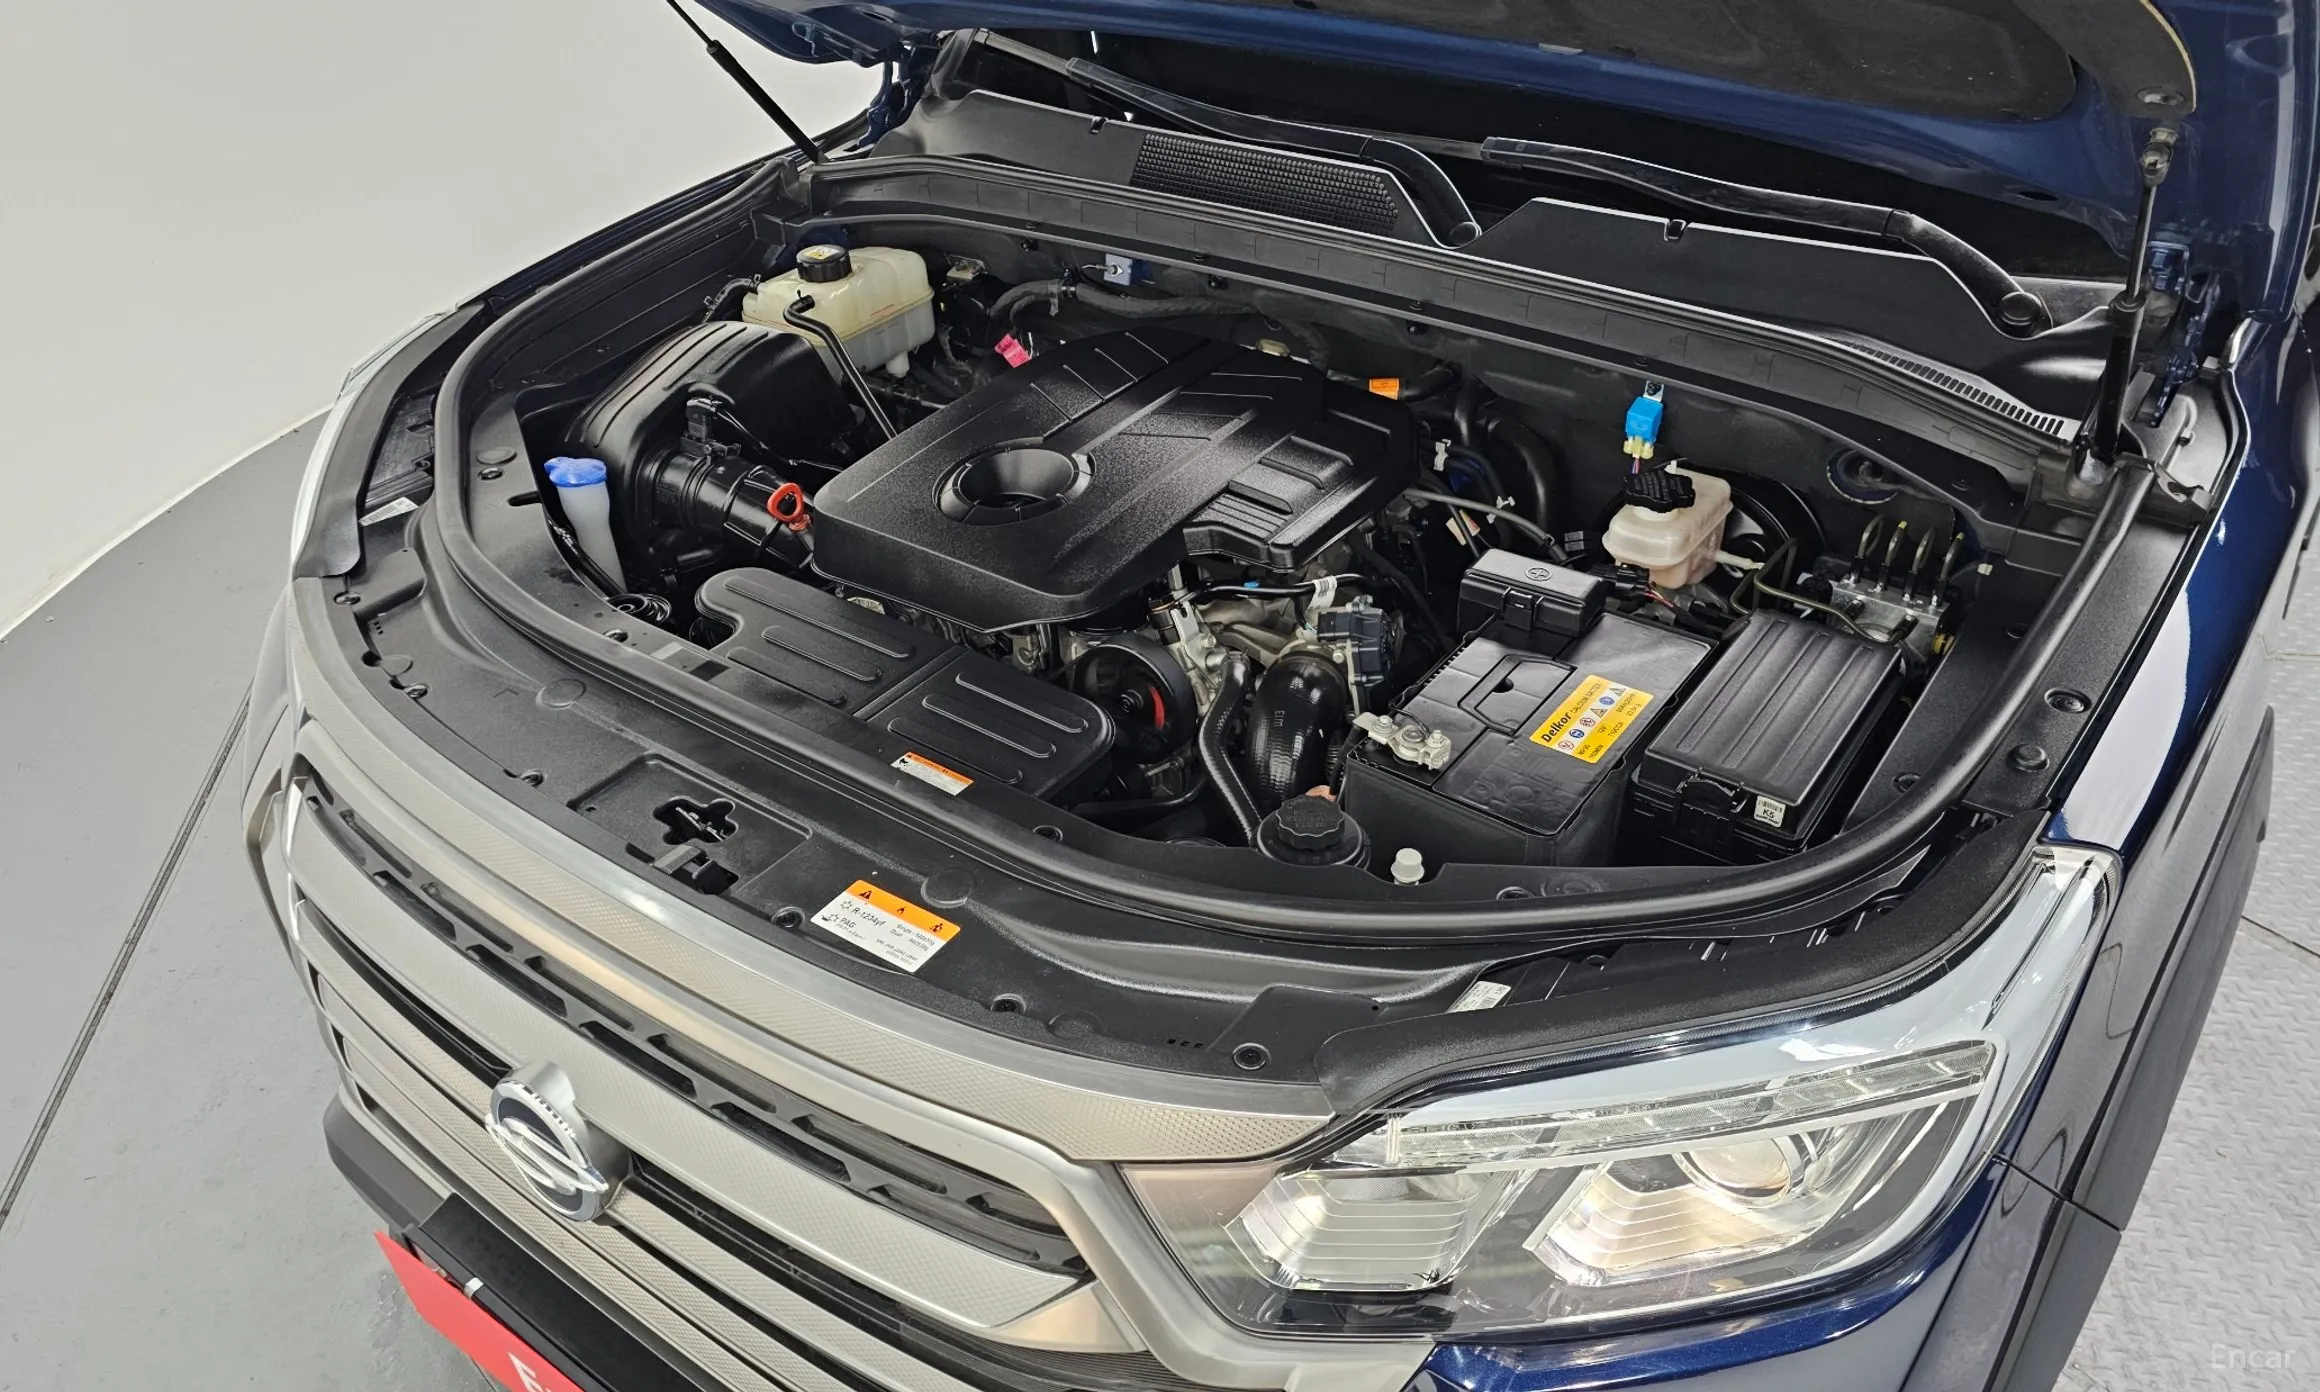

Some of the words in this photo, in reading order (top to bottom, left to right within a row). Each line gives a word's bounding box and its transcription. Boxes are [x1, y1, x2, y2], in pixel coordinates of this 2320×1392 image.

[1541, 712, 1572, 742] Delkor
[840, 917, 857, 929] PAG
[851, 906, 886, 927] R-1234yf
